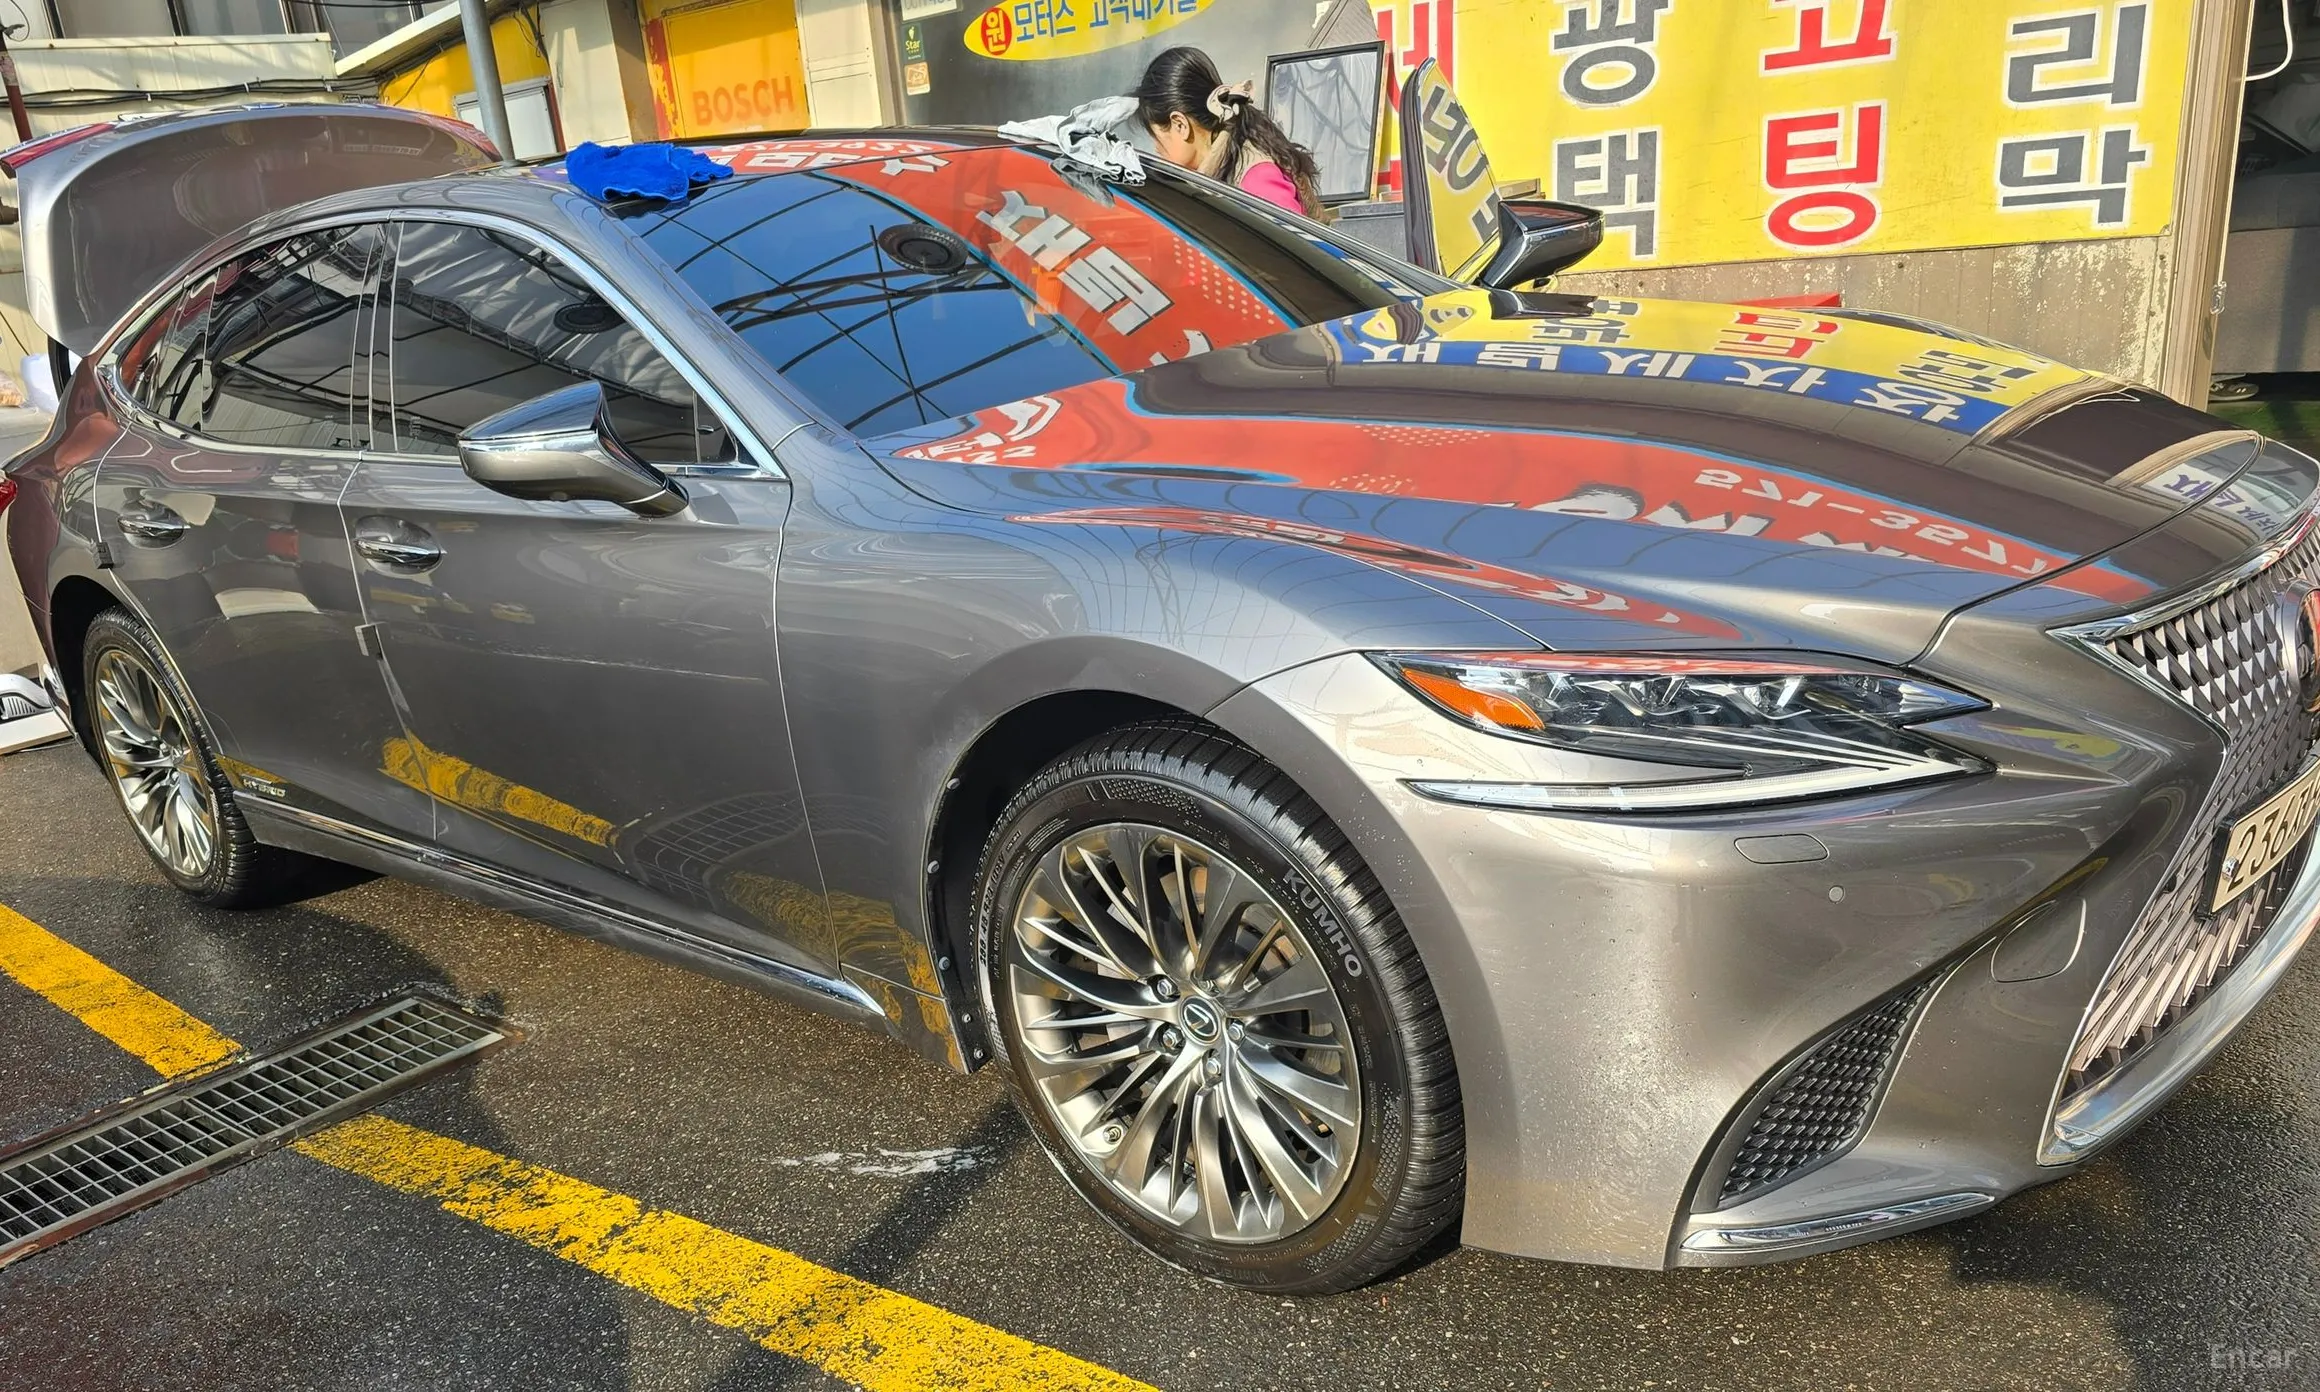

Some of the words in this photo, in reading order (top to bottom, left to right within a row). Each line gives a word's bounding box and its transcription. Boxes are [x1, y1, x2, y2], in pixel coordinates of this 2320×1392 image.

[985, 9, 1006, 52] 원
[1014, 0, 1077, 42] 모터스
[692, 75, 795, 126] BOSCH
[1282, 867, 1363, 978] KUMHO
